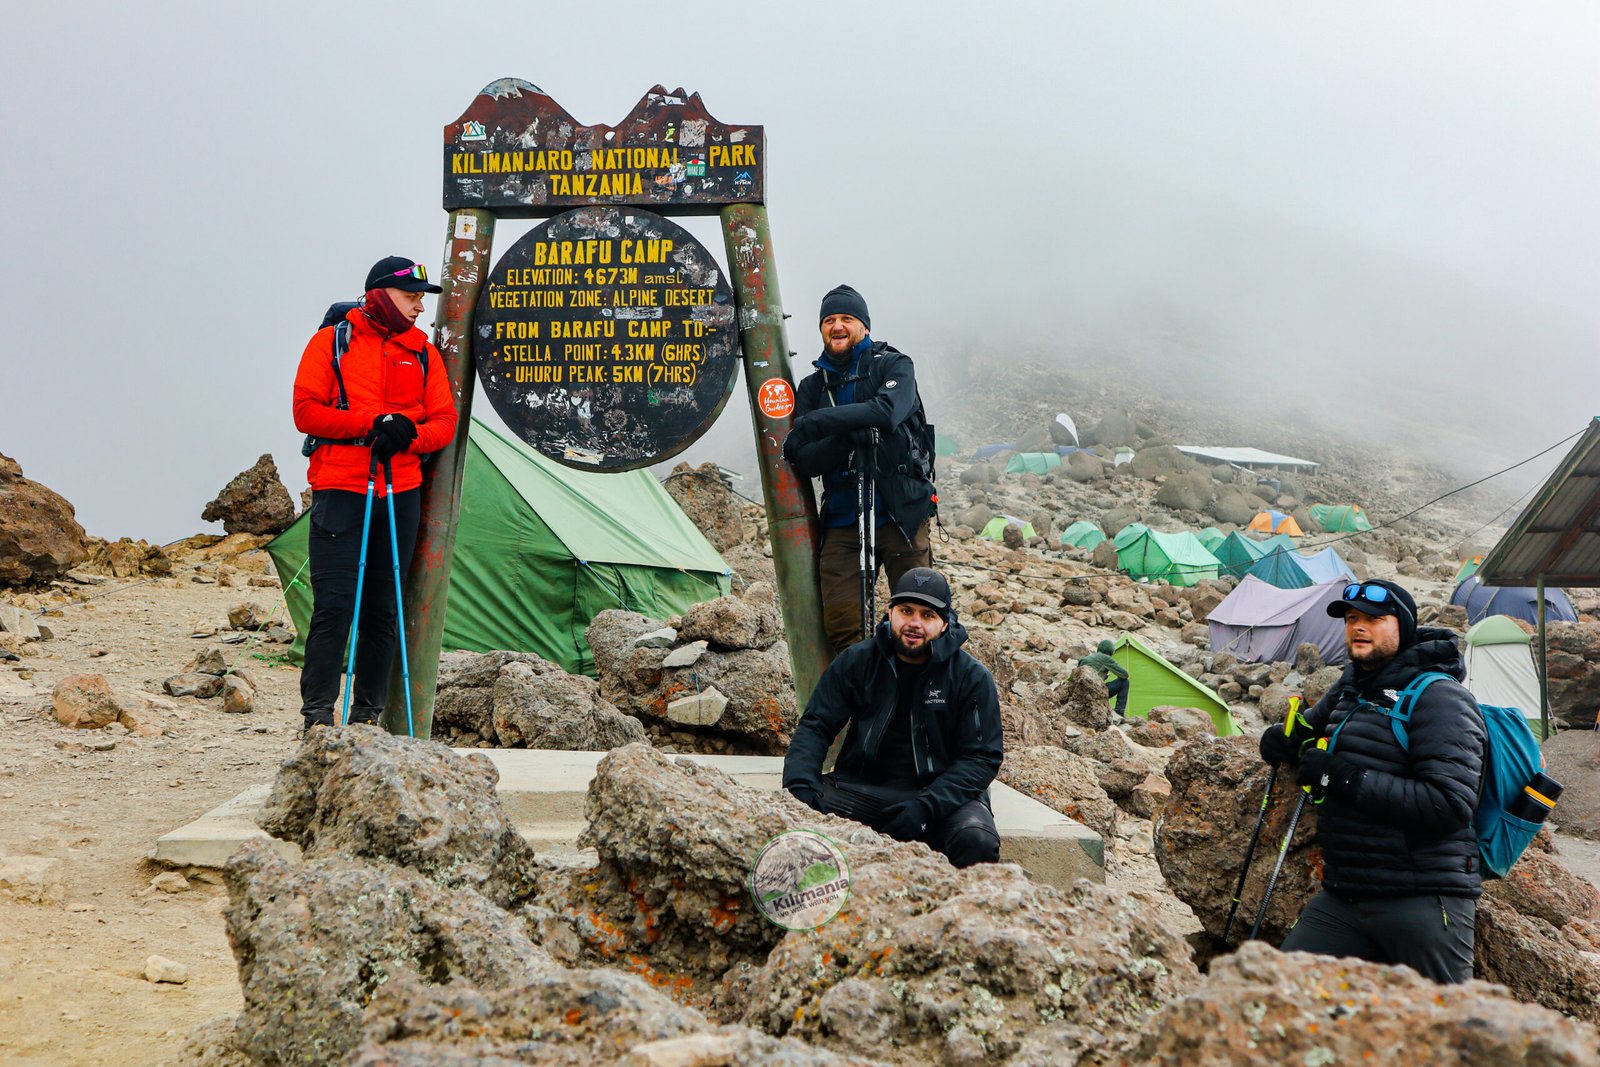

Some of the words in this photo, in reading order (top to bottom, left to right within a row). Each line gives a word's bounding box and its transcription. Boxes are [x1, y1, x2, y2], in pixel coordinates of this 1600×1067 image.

[452, 150, 573, 174] KILIMANJARO
[710, 145, 756, 167] PARK
[550, 173, 643, 196] TANZANIA
[535, 240, 611, 265] BARAFU
[621, 240, 673, 263] CAMP
[507, 268, 578, 285] ELEVATION:
[584, 268, 637, 285] 4673M
[644, 271, 683, 284] amsl
[490, 291, 563, 308] VEGETATION
[570, 290, 606, 307] ZONE:
[613, 290, 657, 306] ALPINE
[666, 289, 714, 306] DESERT
[496, 322, 538, 339] FROM
[551, 320, 614, 338] BARAFU
[628, 321, 671, 337] CAMP
[504, 345, 551, 361] STELLA
[565, 344, 607, 361] POINT:
[611, 344, 654, 360] 4.3KM
[661, 342, 707, 365] (6HRS)
[516, 366, 562, 382] UHURU
[570, 366, 607, 382] PEAK:
[613, 366, 642, 382] 5KM
[647, 363, 697, 387] (7HRS)
